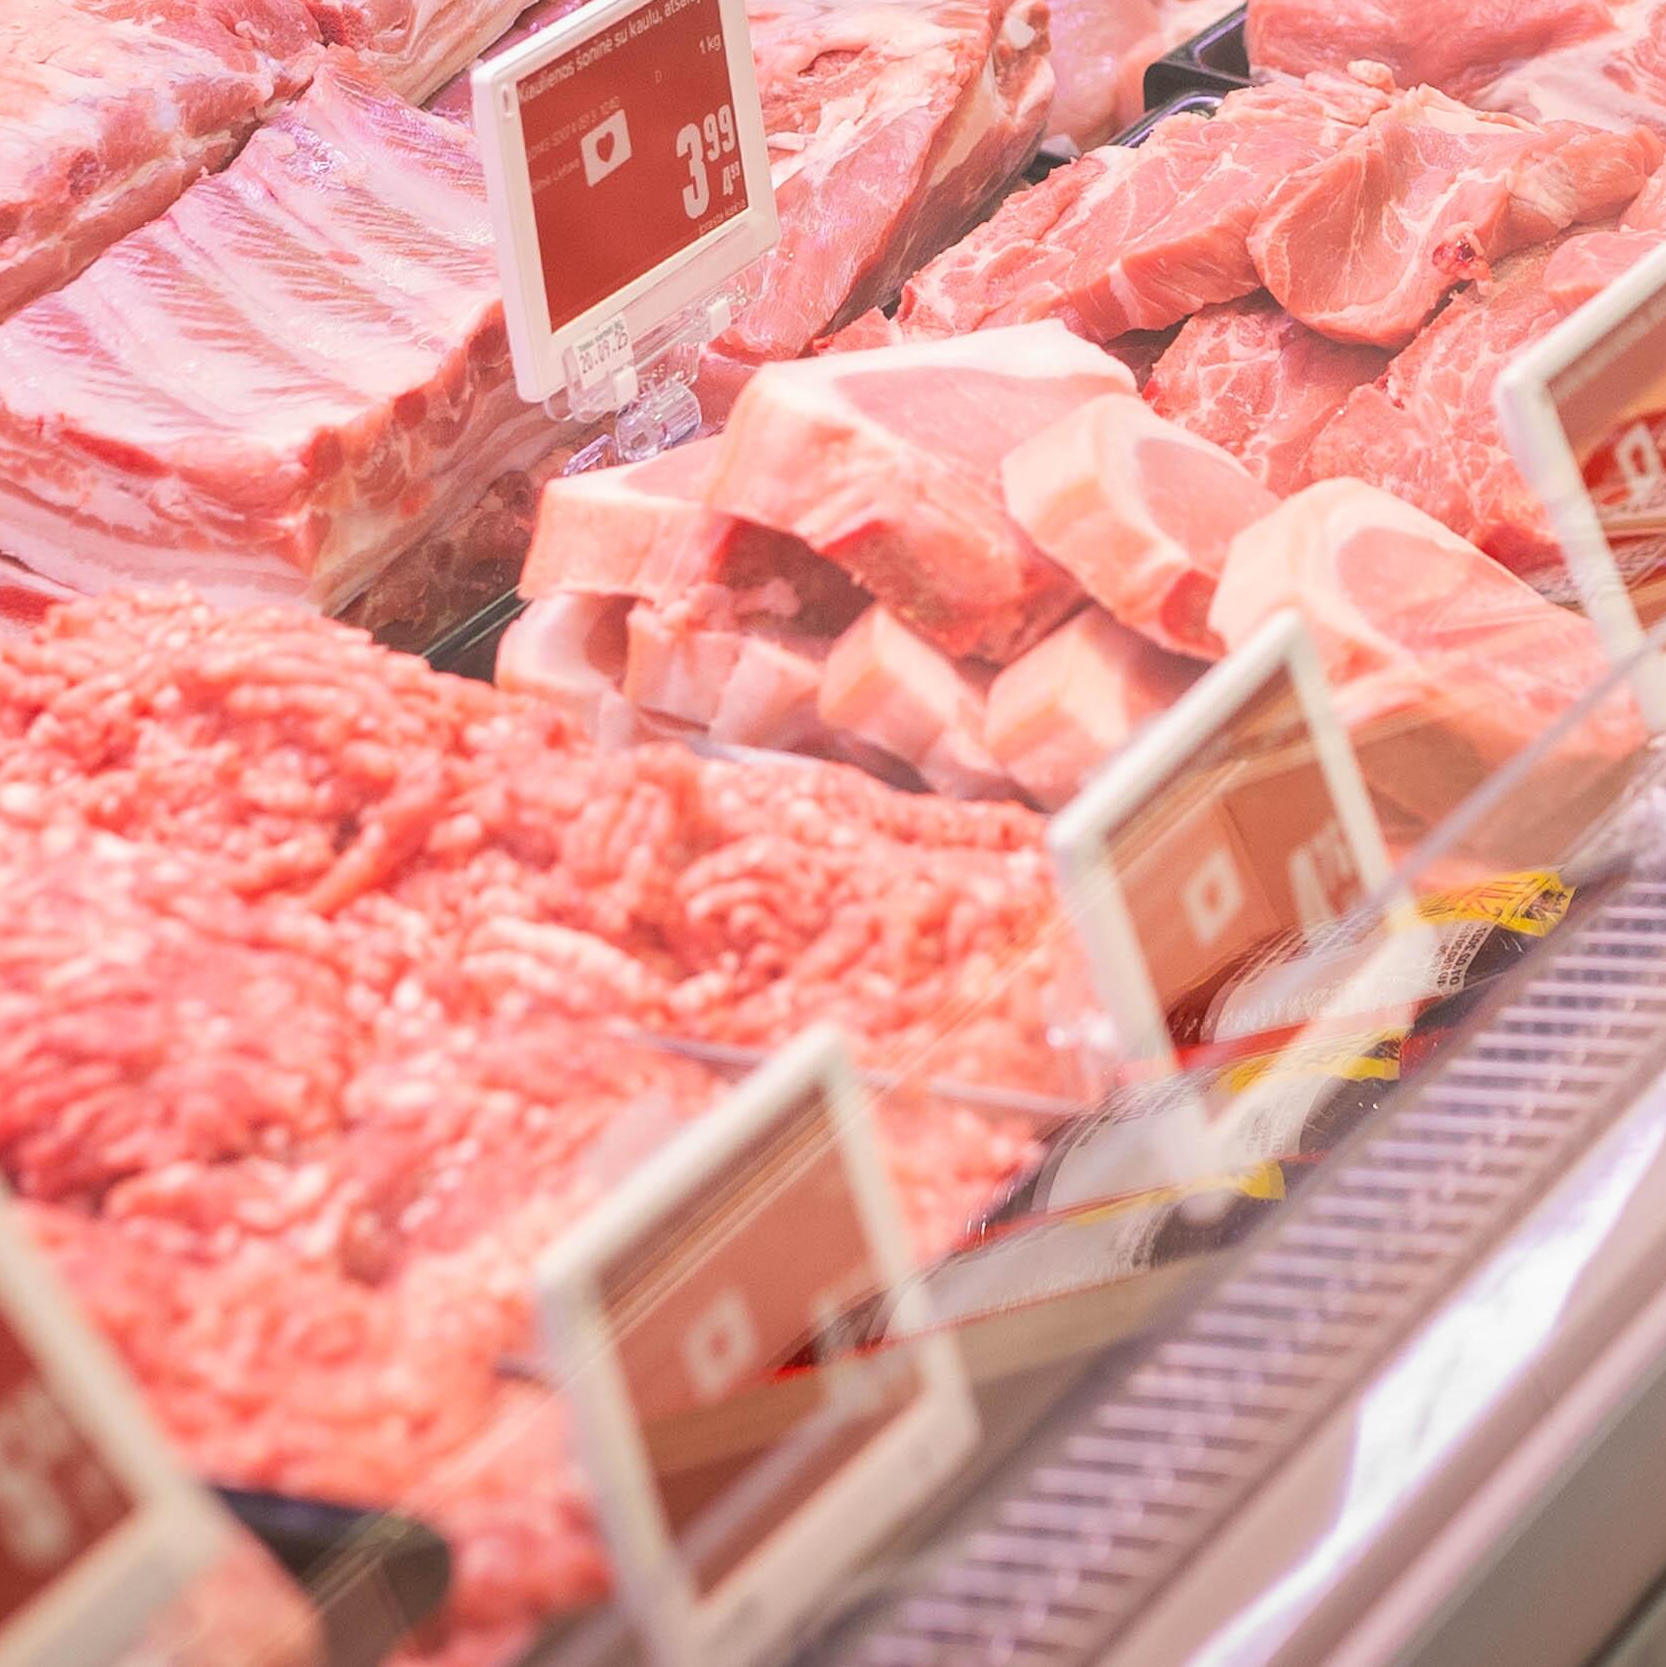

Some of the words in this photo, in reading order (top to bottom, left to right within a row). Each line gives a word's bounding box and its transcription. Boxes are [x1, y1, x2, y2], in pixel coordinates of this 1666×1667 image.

[576, 36, 612, 70] šoninė
[614, 30, 628, 48] su
[629, 12, 662, 38] kaulu,
[707, 35, 721, 52] kg
